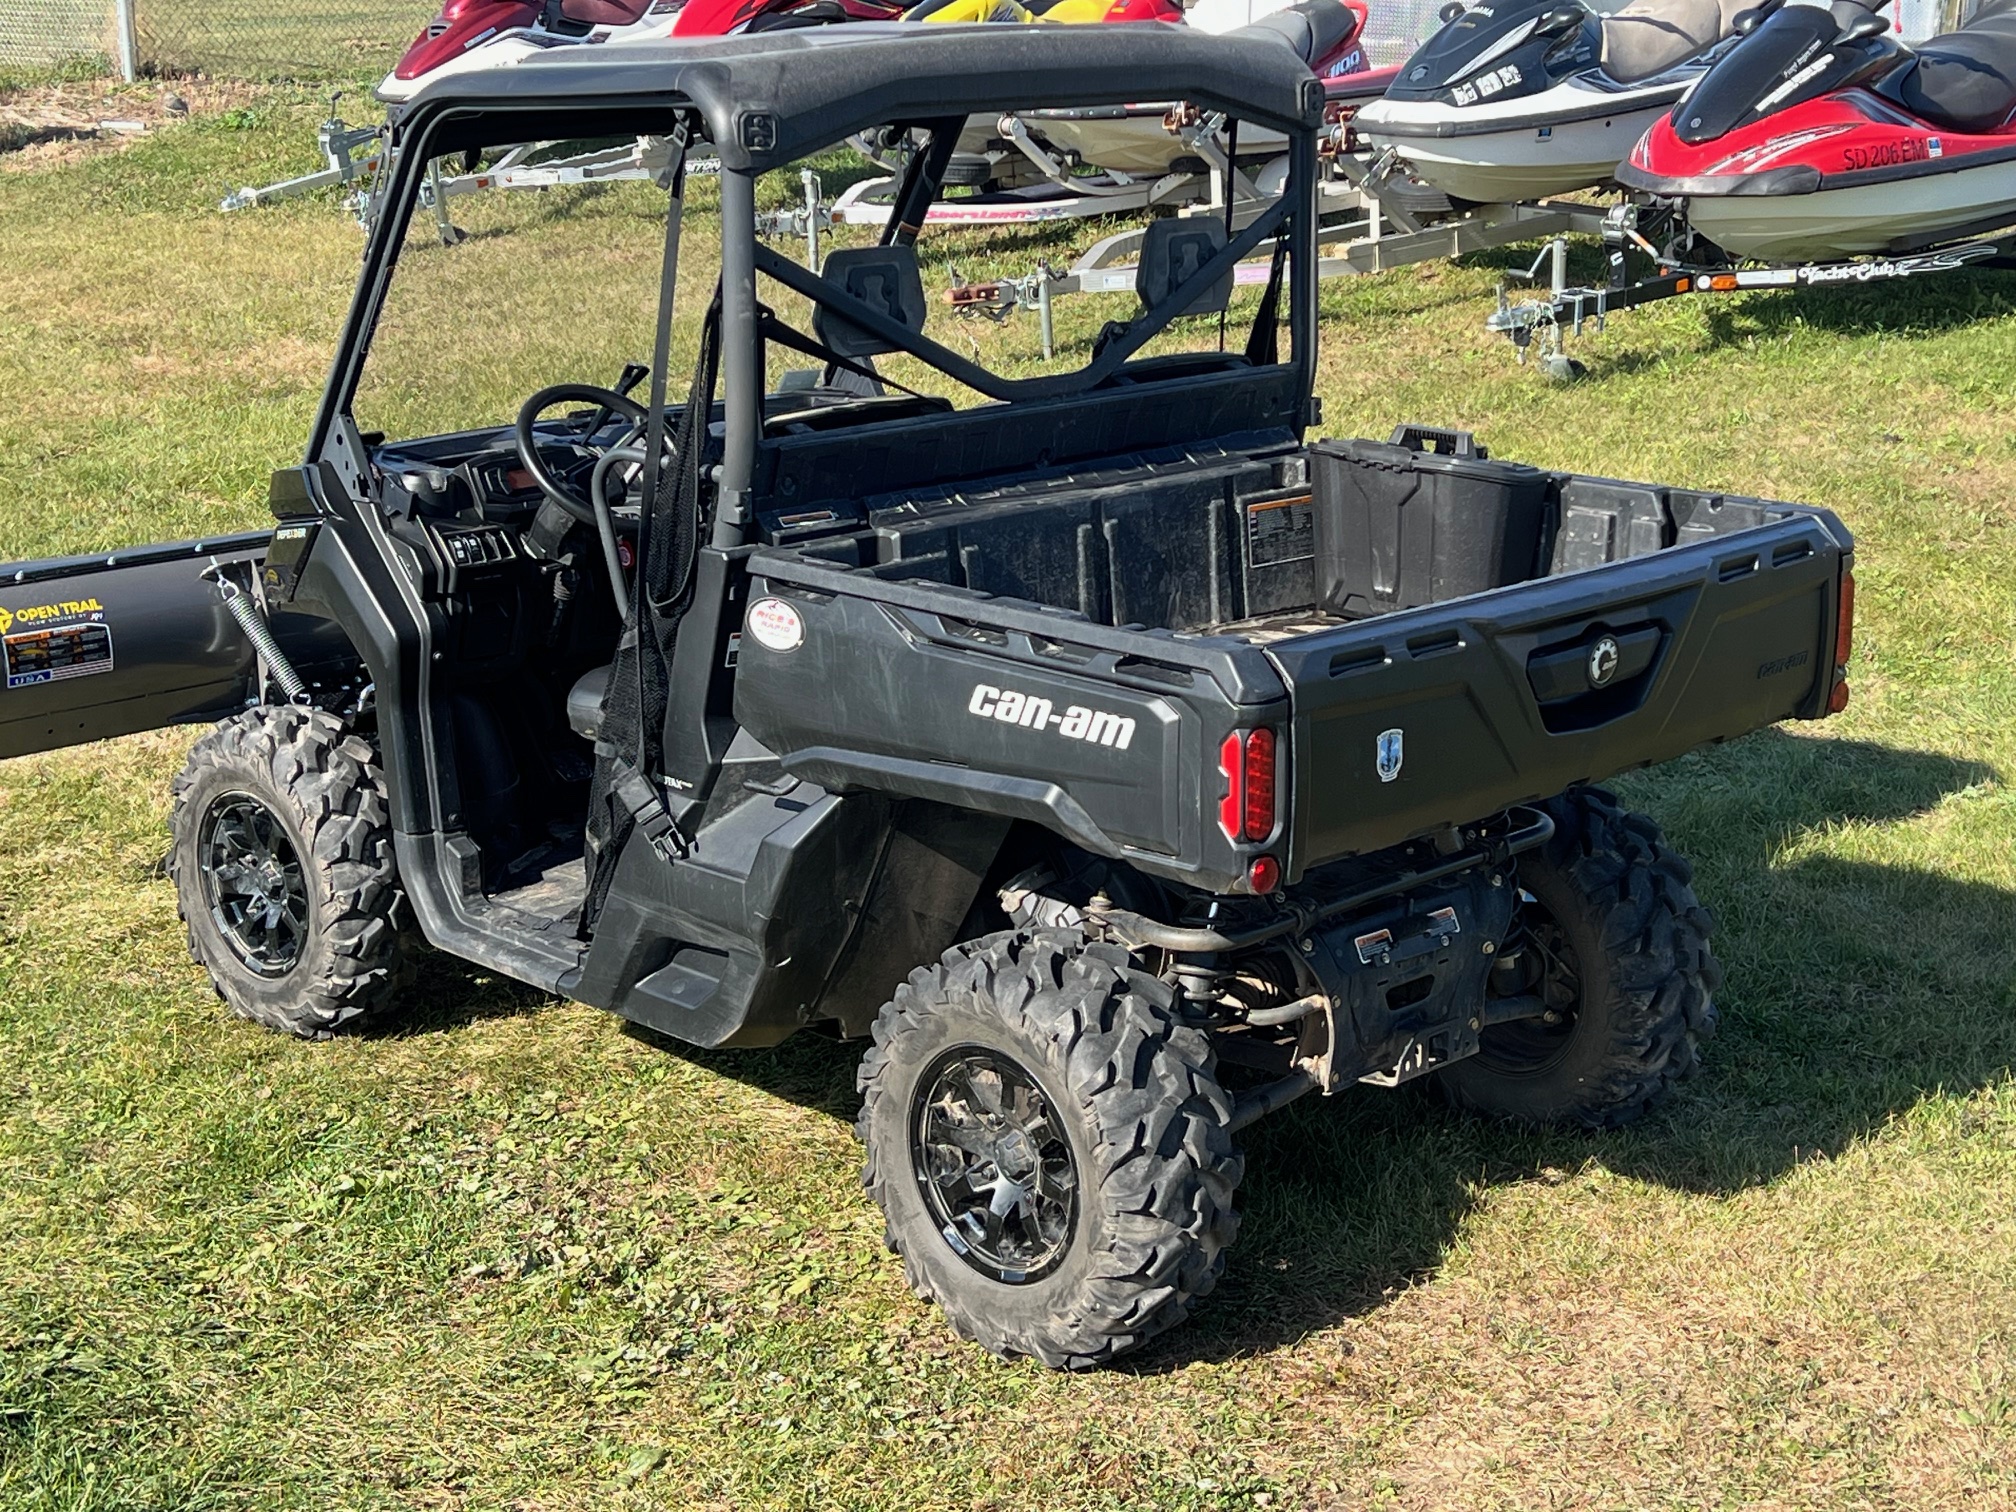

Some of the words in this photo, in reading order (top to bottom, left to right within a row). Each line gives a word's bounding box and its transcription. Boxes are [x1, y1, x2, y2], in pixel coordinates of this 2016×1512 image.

[1330, 50, 1360, 78] 1100
[1843, 148, 1867, 170] SD
[1870, 141, 1899, 167] 206
[1798, 266, 1850, 285] Yacht
[1850, 261, 1895, 281] Club
[16, 604, 60, 622] OPEN
[59, 598, 103, 615] TRAIL
[968, 683, 1137, 750] can-am
